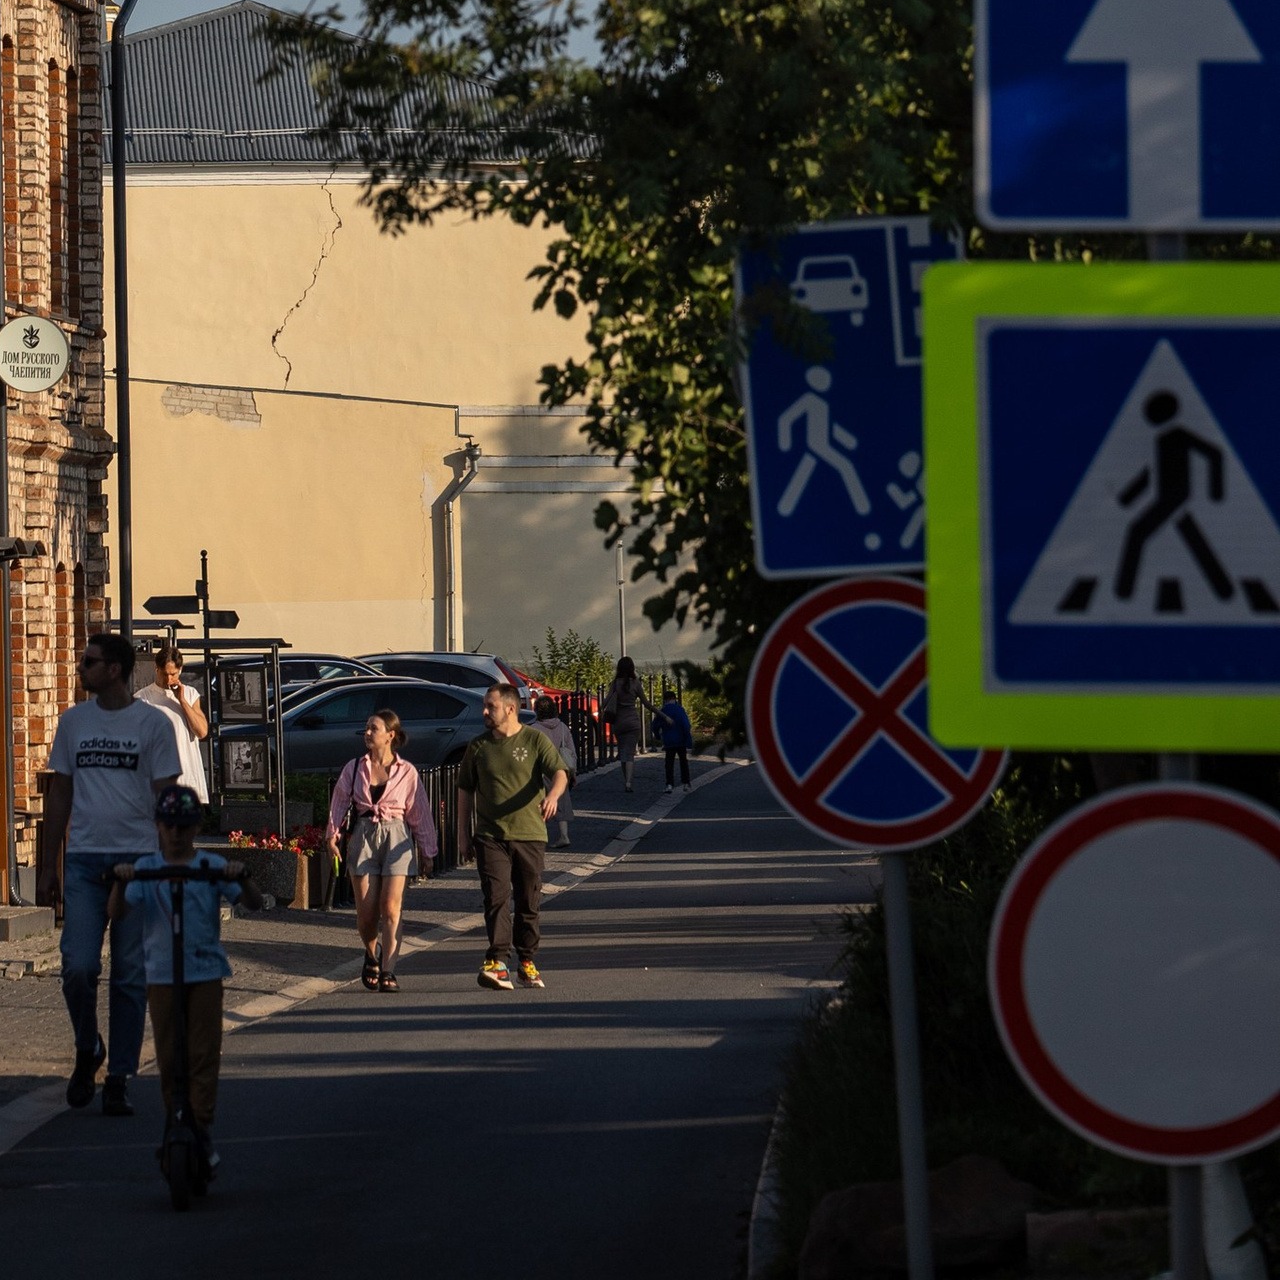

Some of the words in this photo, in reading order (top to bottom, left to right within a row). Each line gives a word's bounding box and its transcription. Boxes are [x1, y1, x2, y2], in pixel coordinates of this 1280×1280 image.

[1, 351, 19, 365] ДОМ
[21, 351, 60, 365] РУССКОГО
[9, 365, 51, 379] ЧАЕПИТИЯ
[80, 737, 120, 749] adidas
[78, 753, 119, 767] adidas
